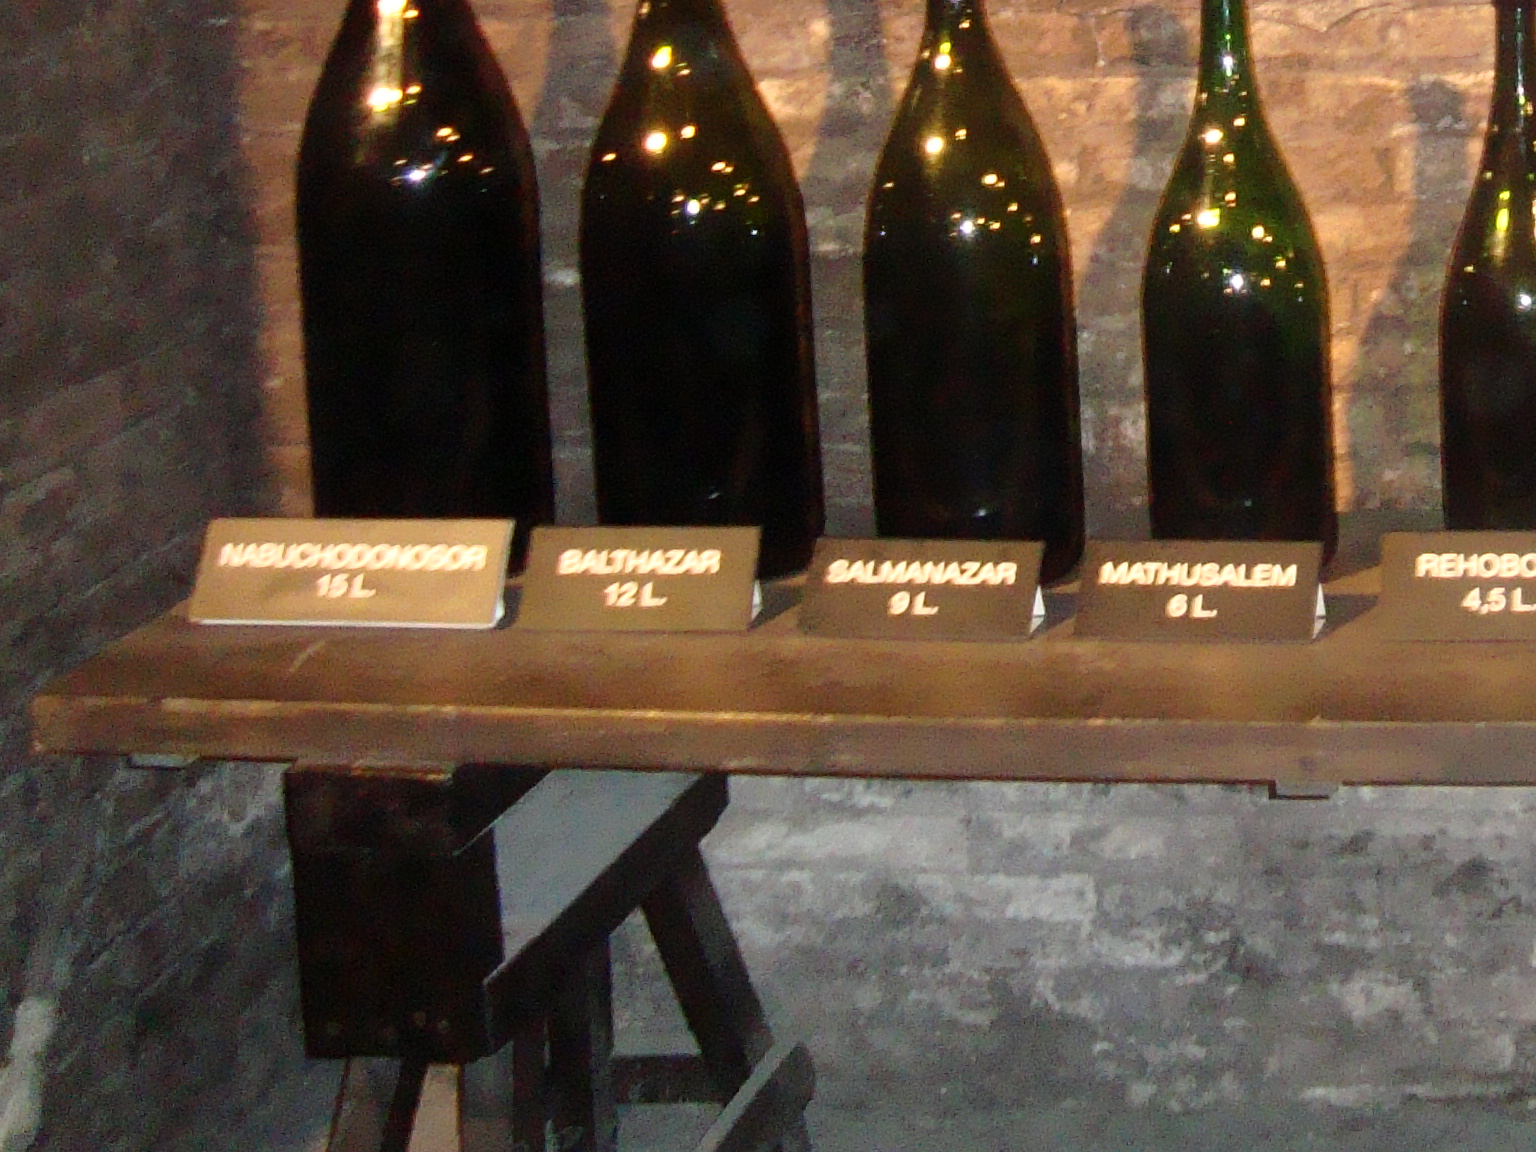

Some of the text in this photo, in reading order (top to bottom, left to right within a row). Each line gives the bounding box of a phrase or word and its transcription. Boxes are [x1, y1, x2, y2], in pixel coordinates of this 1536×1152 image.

[217, 541, 489, 571] NABUCHODONOSOR
[557, 548, 722, 575] BALTHAZAR
[825, 558, 1018, 586] SALMANAZAR
[1098, 560, 1297, 587] MATHUSALEM
[316, 573, 349, 599] 15
[603, 581, 639, 608] 12
[888, 591, 911, 616] 9
[1165, 593, 1188, 618] 6
